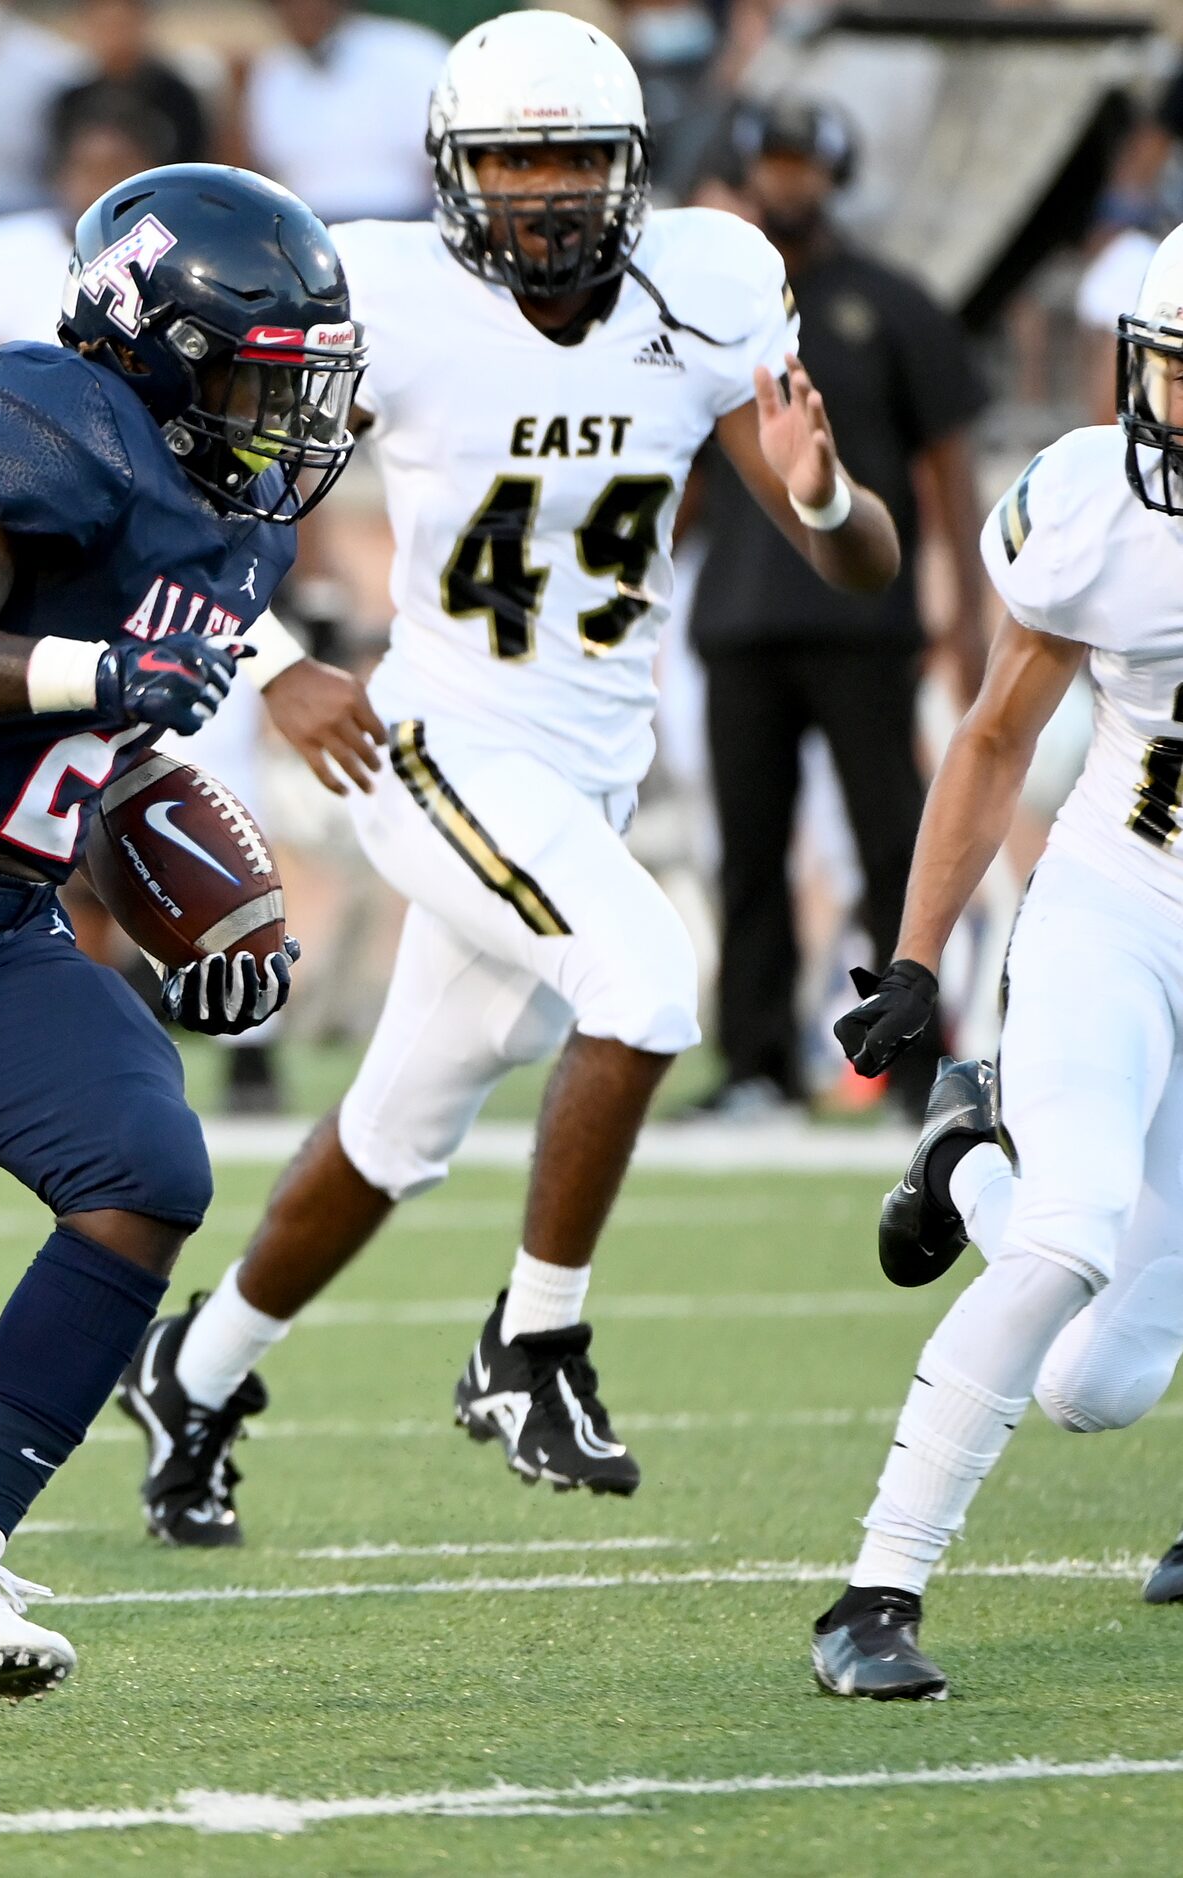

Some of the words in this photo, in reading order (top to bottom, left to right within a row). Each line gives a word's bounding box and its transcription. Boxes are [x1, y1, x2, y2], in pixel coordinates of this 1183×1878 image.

[509, 415, 634, 459] EAST
[439, 472, 676, 664] 49
[120, 833, 151, 882] VAPOR
[147, 880, 184, 919] ELITE
